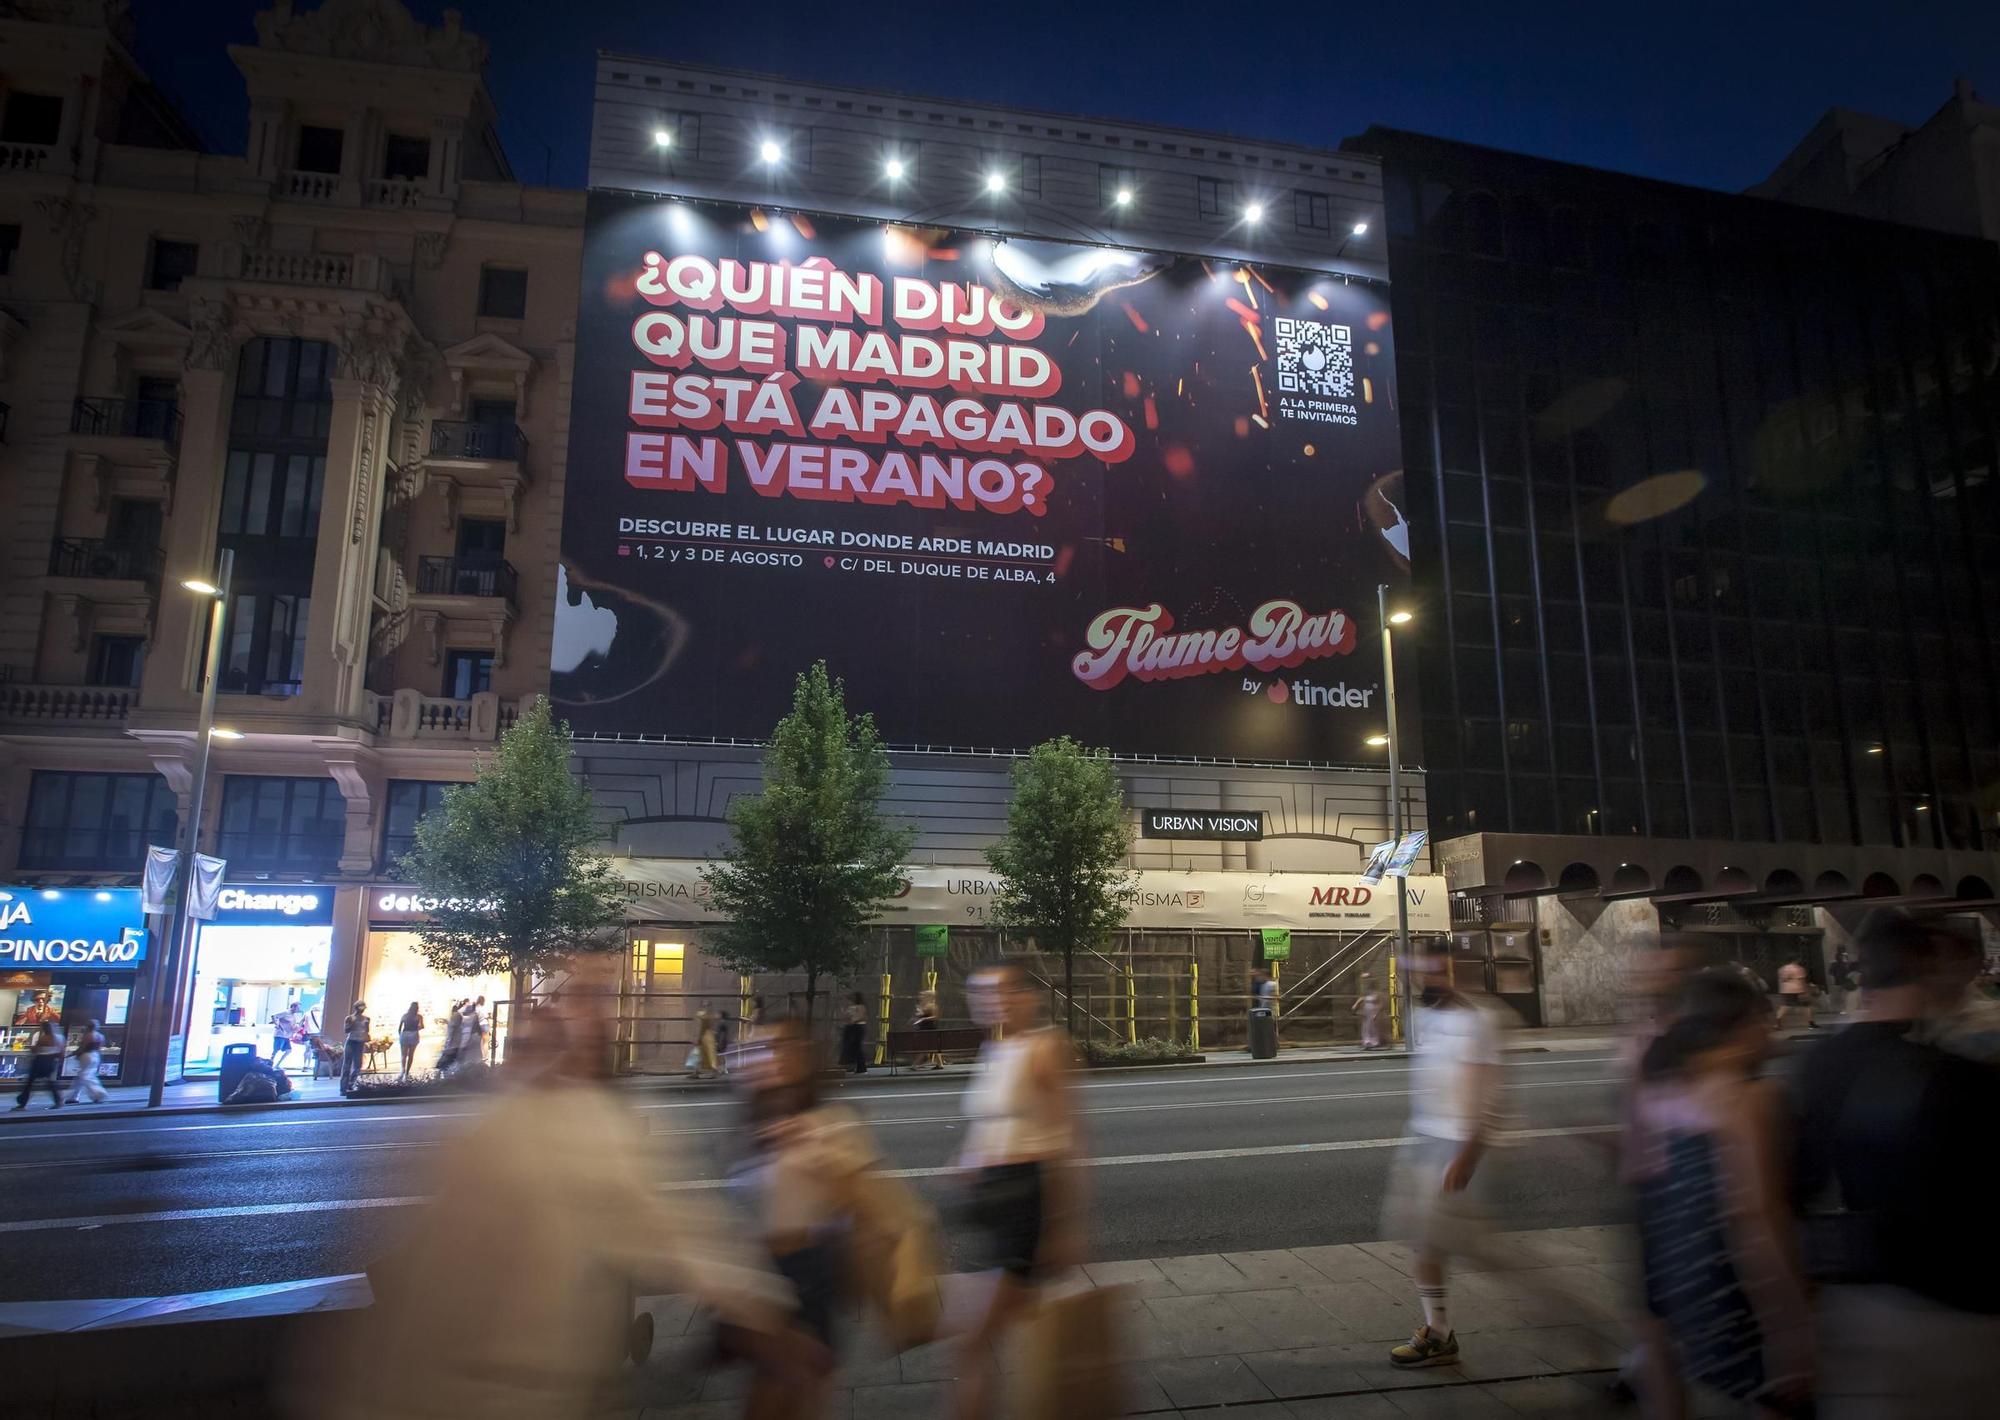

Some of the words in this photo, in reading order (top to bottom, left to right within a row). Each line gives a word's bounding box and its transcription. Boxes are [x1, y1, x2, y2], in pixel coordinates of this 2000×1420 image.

[635, 252, 876, 316] ¿QUIÉN
[893, 277, 1037, 332] DIJO
[633, 312, 777, 366] QUE
[797, 326, 1053, 389] MADRID
[630, 370, 795, 428] ESTÁ
[810, 386, 1127, 454] APAGADO
[1280, 397, 1288, 407] A
[1291, 398, 1305, 409] LA
[1308, 400, 1357, 414] PRIMERA
[1280, 408, 1295, 418] TE
[1297, 410, 1358, 425] INVITAMOS
[626, 433, 716, 484] EN
[736, 440, 1045, 507] VERANO?
[618, 517, 731, 539] DESCUBRE
[737, 525, 760, 541] EL
[766, 526, 836, 545] LUGAR
[840, 531, 914, 550] DONDE
[917, 537, 972, 554] ARDE
[977, 541, 1055, 559] MADRID
[636, 544, 649, 560] 1,
[654, 545, 665, 559] 2
[669, 549, 681, 563] y
[684, 547, 696, 561] 3
[701, 549, 725, 563] DE
[729, 550, 803, 568] AGOSTO
[840, 557, 859, 571] C/
[863, 559, 896, 573] DEL
[900, 561, 962, 578] DUQUE
[967, 566, 989, 579] DE
[993, 568, 1041, 585] ALBA,
[1045, 571, 1056, 584] 4
[1073, 604, 1241, 681] Flame
[1241, 600, 1347, 663] Bar
[1242, 678, 1262, 695] by
[1292, 680, 1374, 708] tinder
[1152, 816, 1203, 831] URBAN
[1208, 817, 1258, 832] VISION
[218, 889, 319, 915] Change
[614, 882, 689, 898] PRISMA
[1117, 891, 1183, 907] PRISMA
[1308, 886, 1372, 906] MRD
